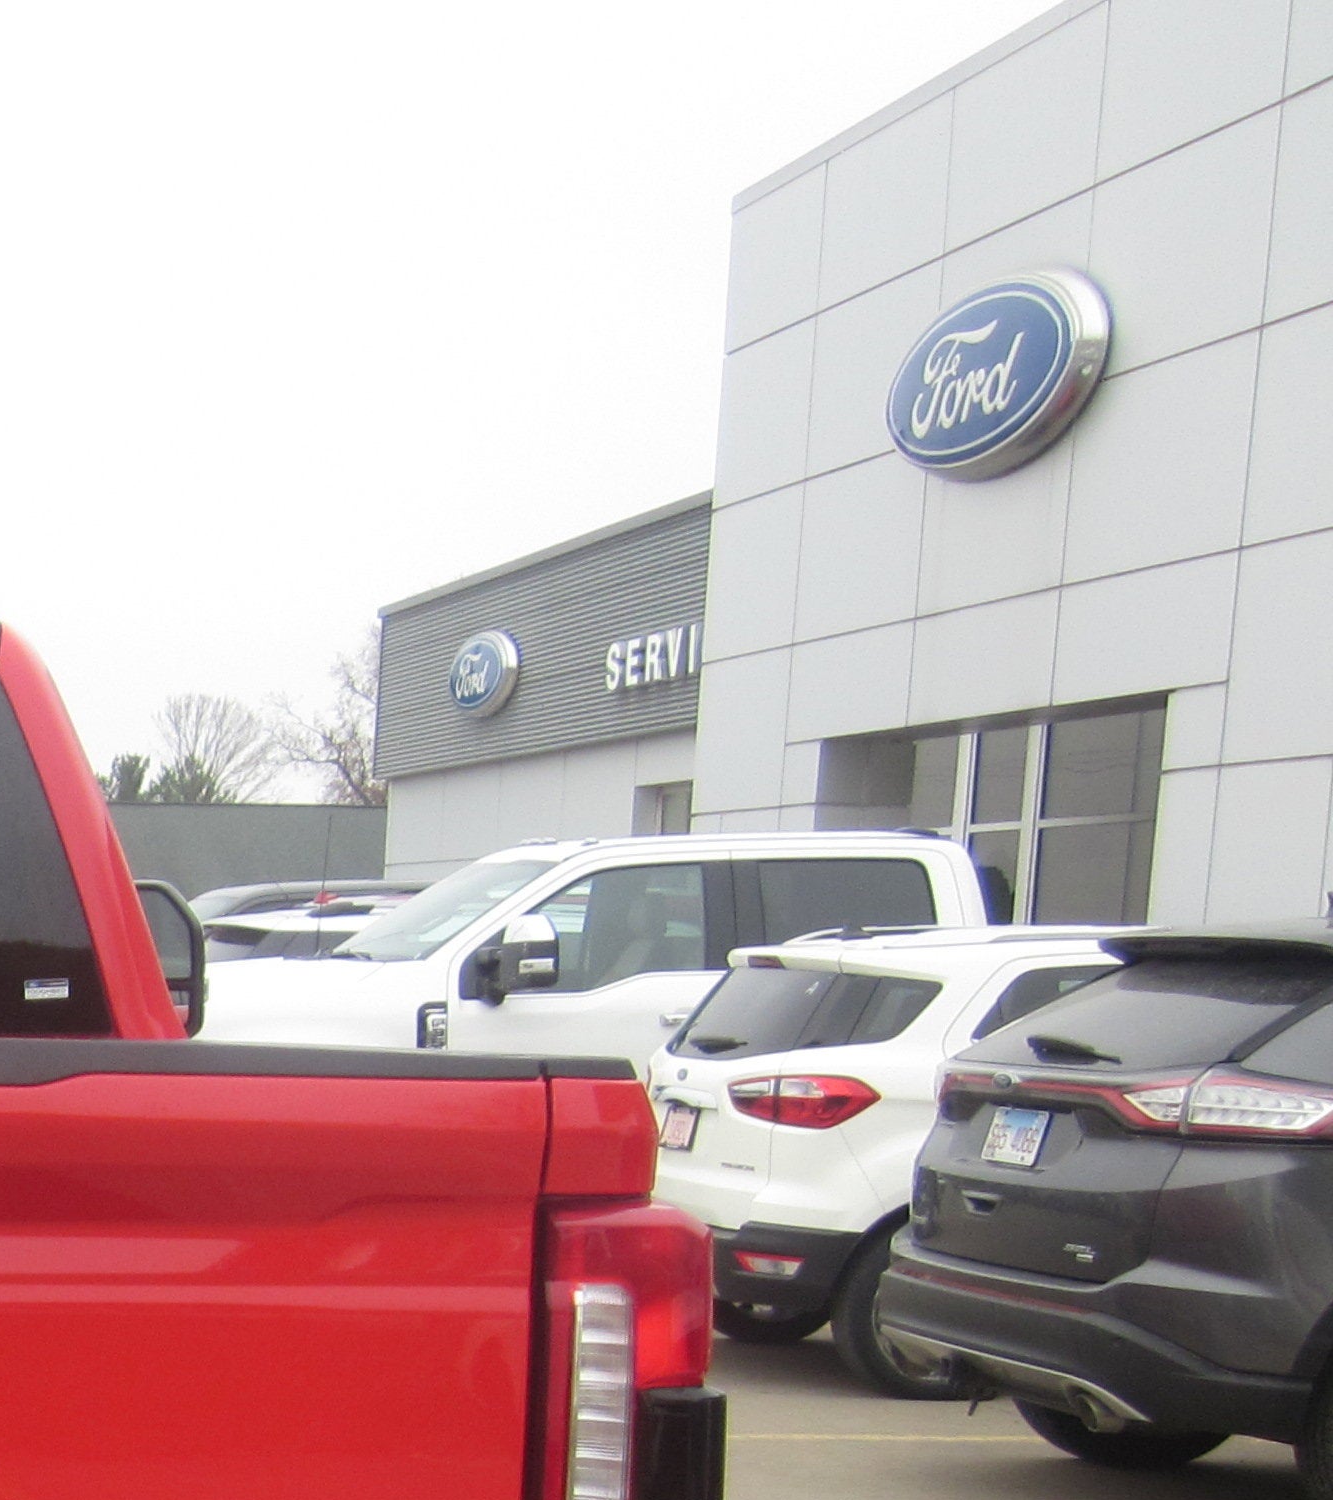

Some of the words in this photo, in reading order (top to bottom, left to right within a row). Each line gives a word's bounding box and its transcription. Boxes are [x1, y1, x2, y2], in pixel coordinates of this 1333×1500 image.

[910, 319, 1026, 440] Ford
[455, 652, 490, 700] Ford
[605, 624, 703, 692] SERVI
